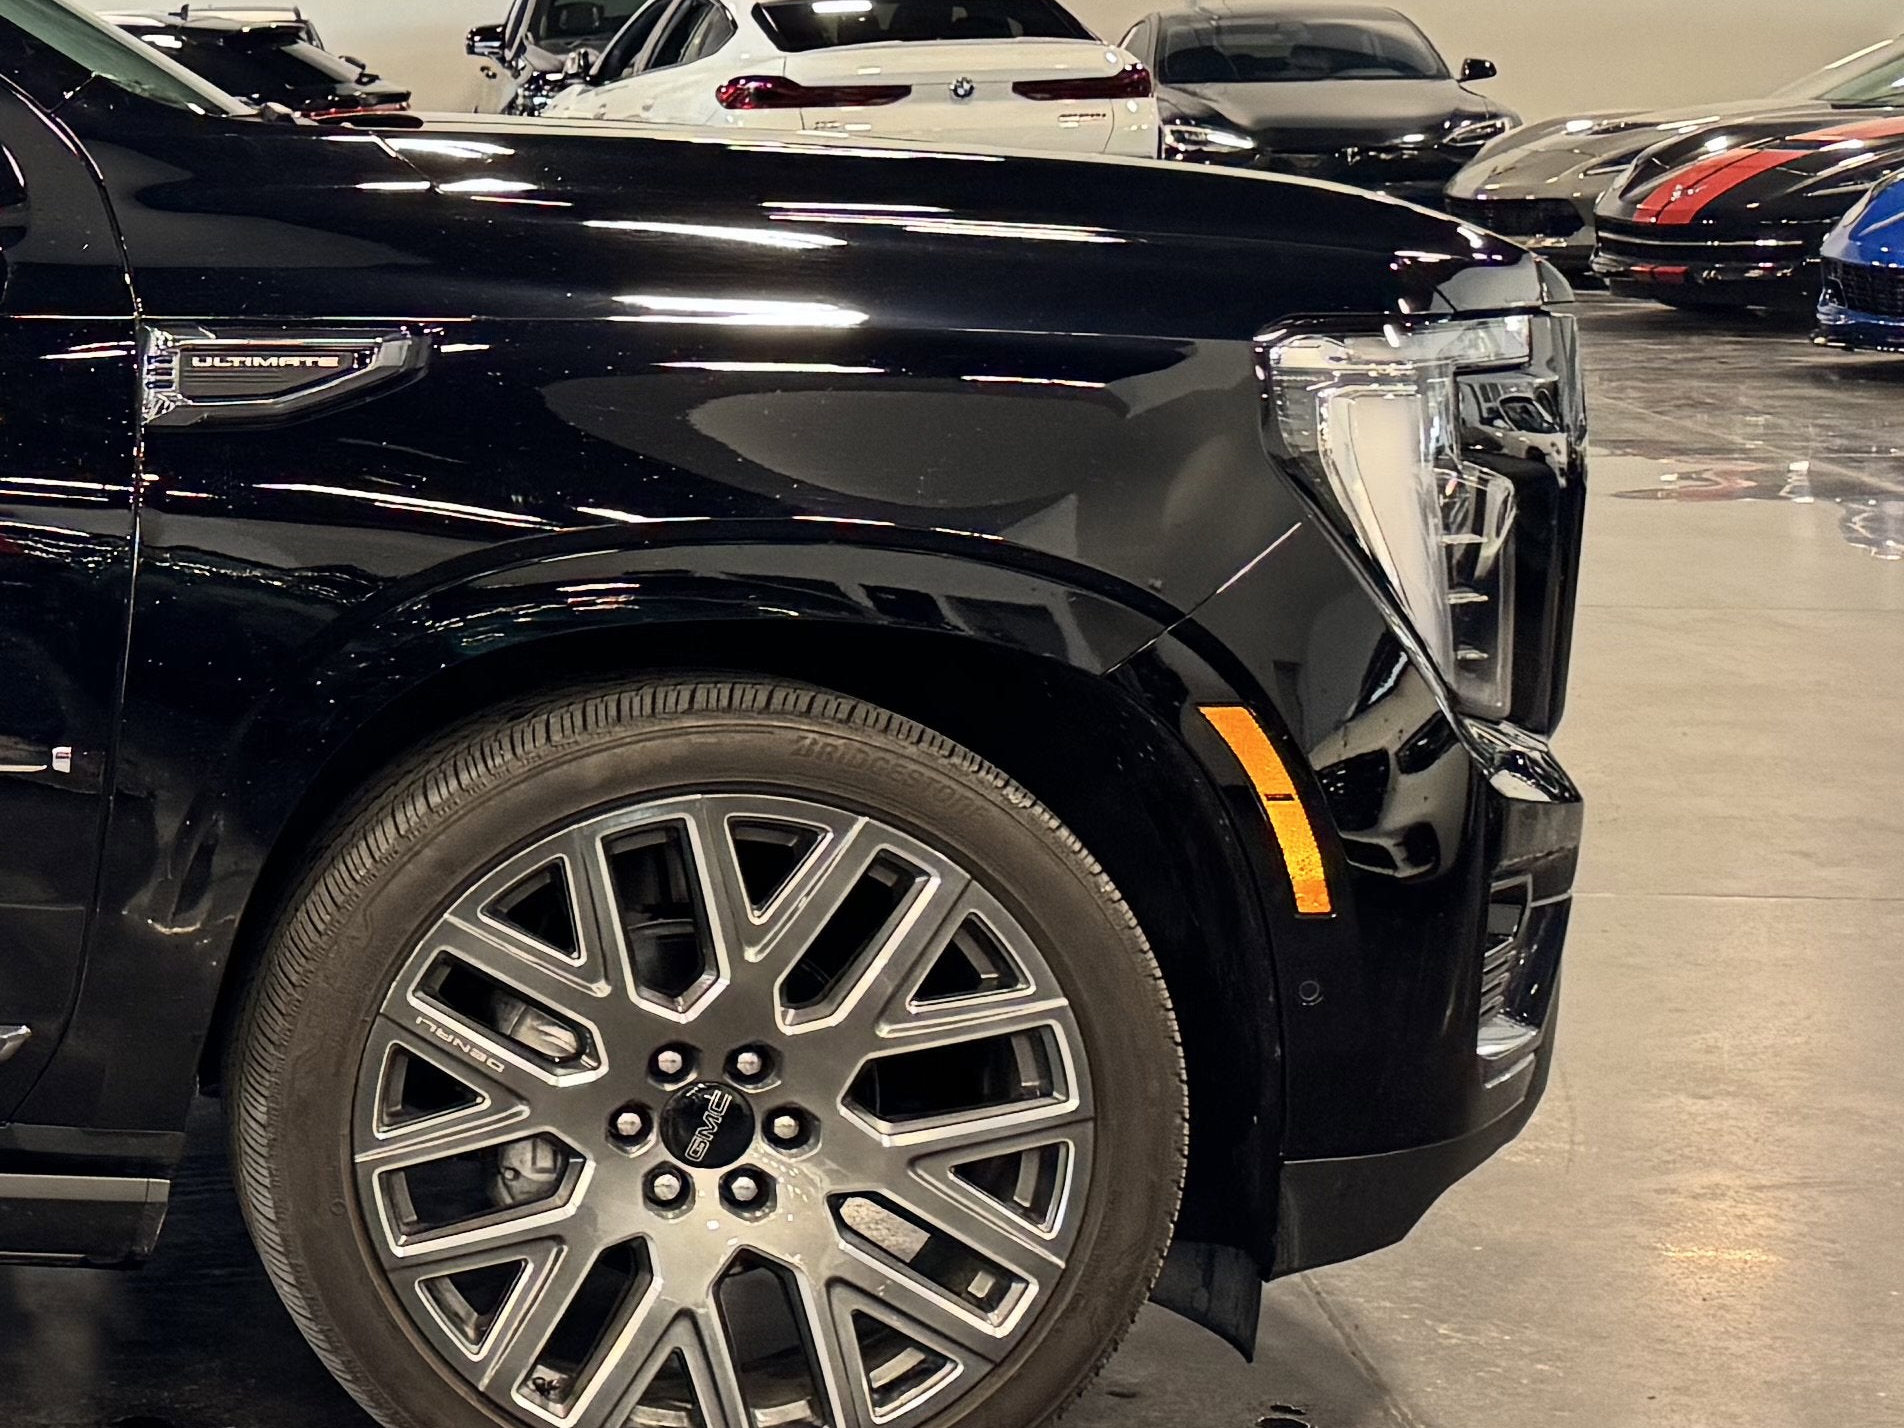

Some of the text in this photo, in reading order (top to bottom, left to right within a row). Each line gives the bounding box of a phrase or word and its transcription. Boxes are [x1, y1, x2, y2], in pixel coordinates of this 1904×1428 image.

[191, 356, 339, 368] ULTIMATE
[415, 1015, 506, 1073] DENALI
[684, 1089, 733, 1162] GMC
